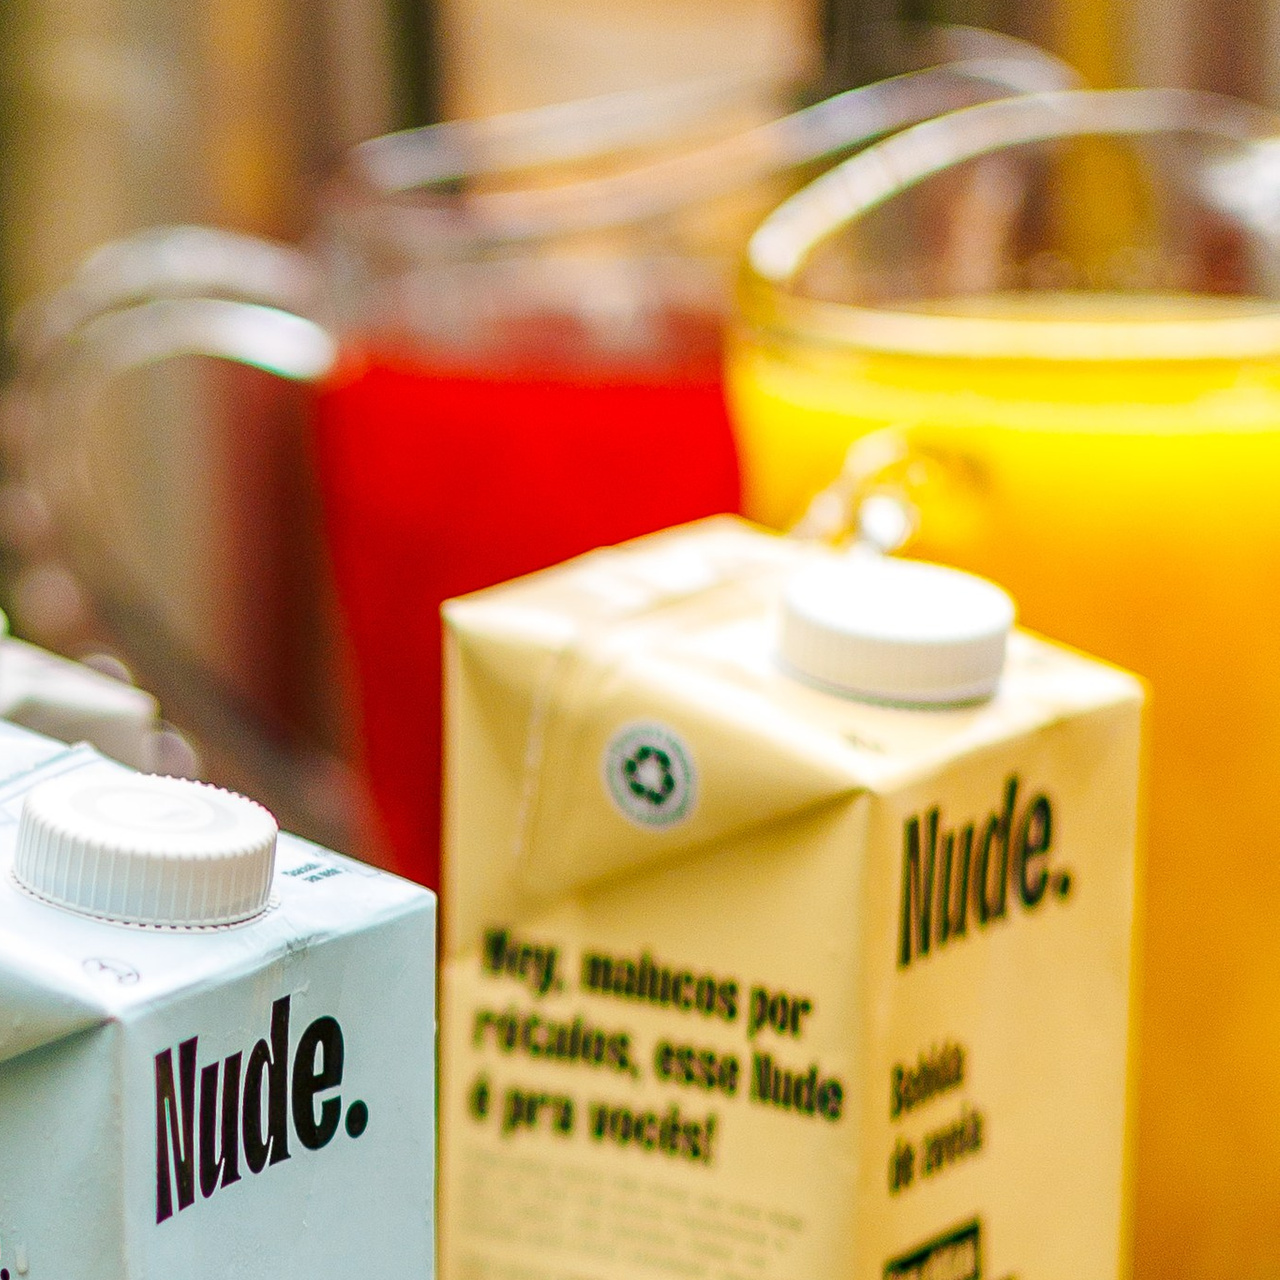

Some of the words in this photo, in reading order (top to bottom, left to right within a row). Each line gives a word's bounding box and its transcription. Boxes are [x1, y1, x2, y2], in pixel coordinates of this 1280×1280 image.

[900, 773, 1071, 970] Nude.
[154, 995, 370, 1224] Nude.
[748, 984, 812, 1039] por
